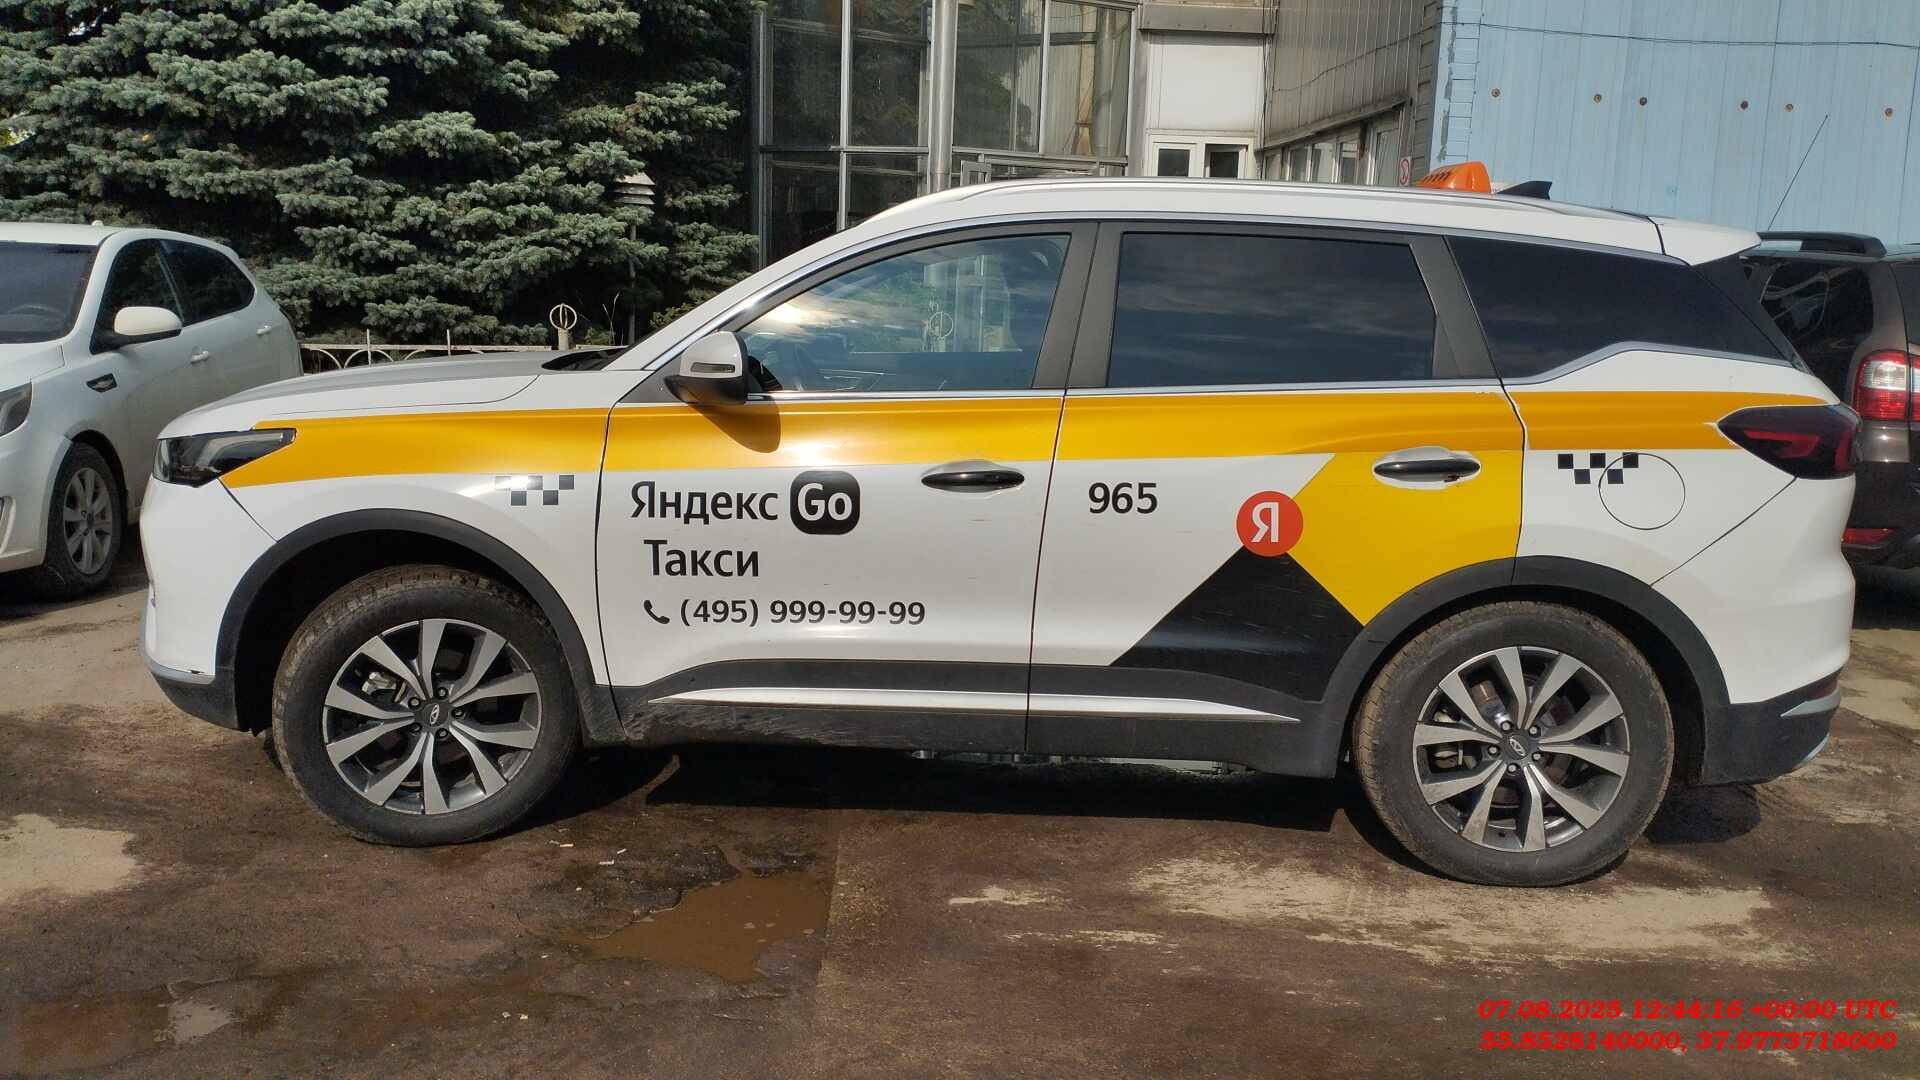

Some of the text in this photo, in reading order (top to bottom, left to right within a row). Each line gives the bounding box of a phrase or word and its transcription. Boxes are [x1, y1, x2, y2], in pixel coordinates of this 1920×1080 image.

[630, 480, 853, 525] Яндекс Go
[1088, 481, 1158, 515] 965
[1250, 501, 1280, 544] Я
[643, 539, 760, 578] Такси
[680, 598, 926, 627] (495) 999-99-99
